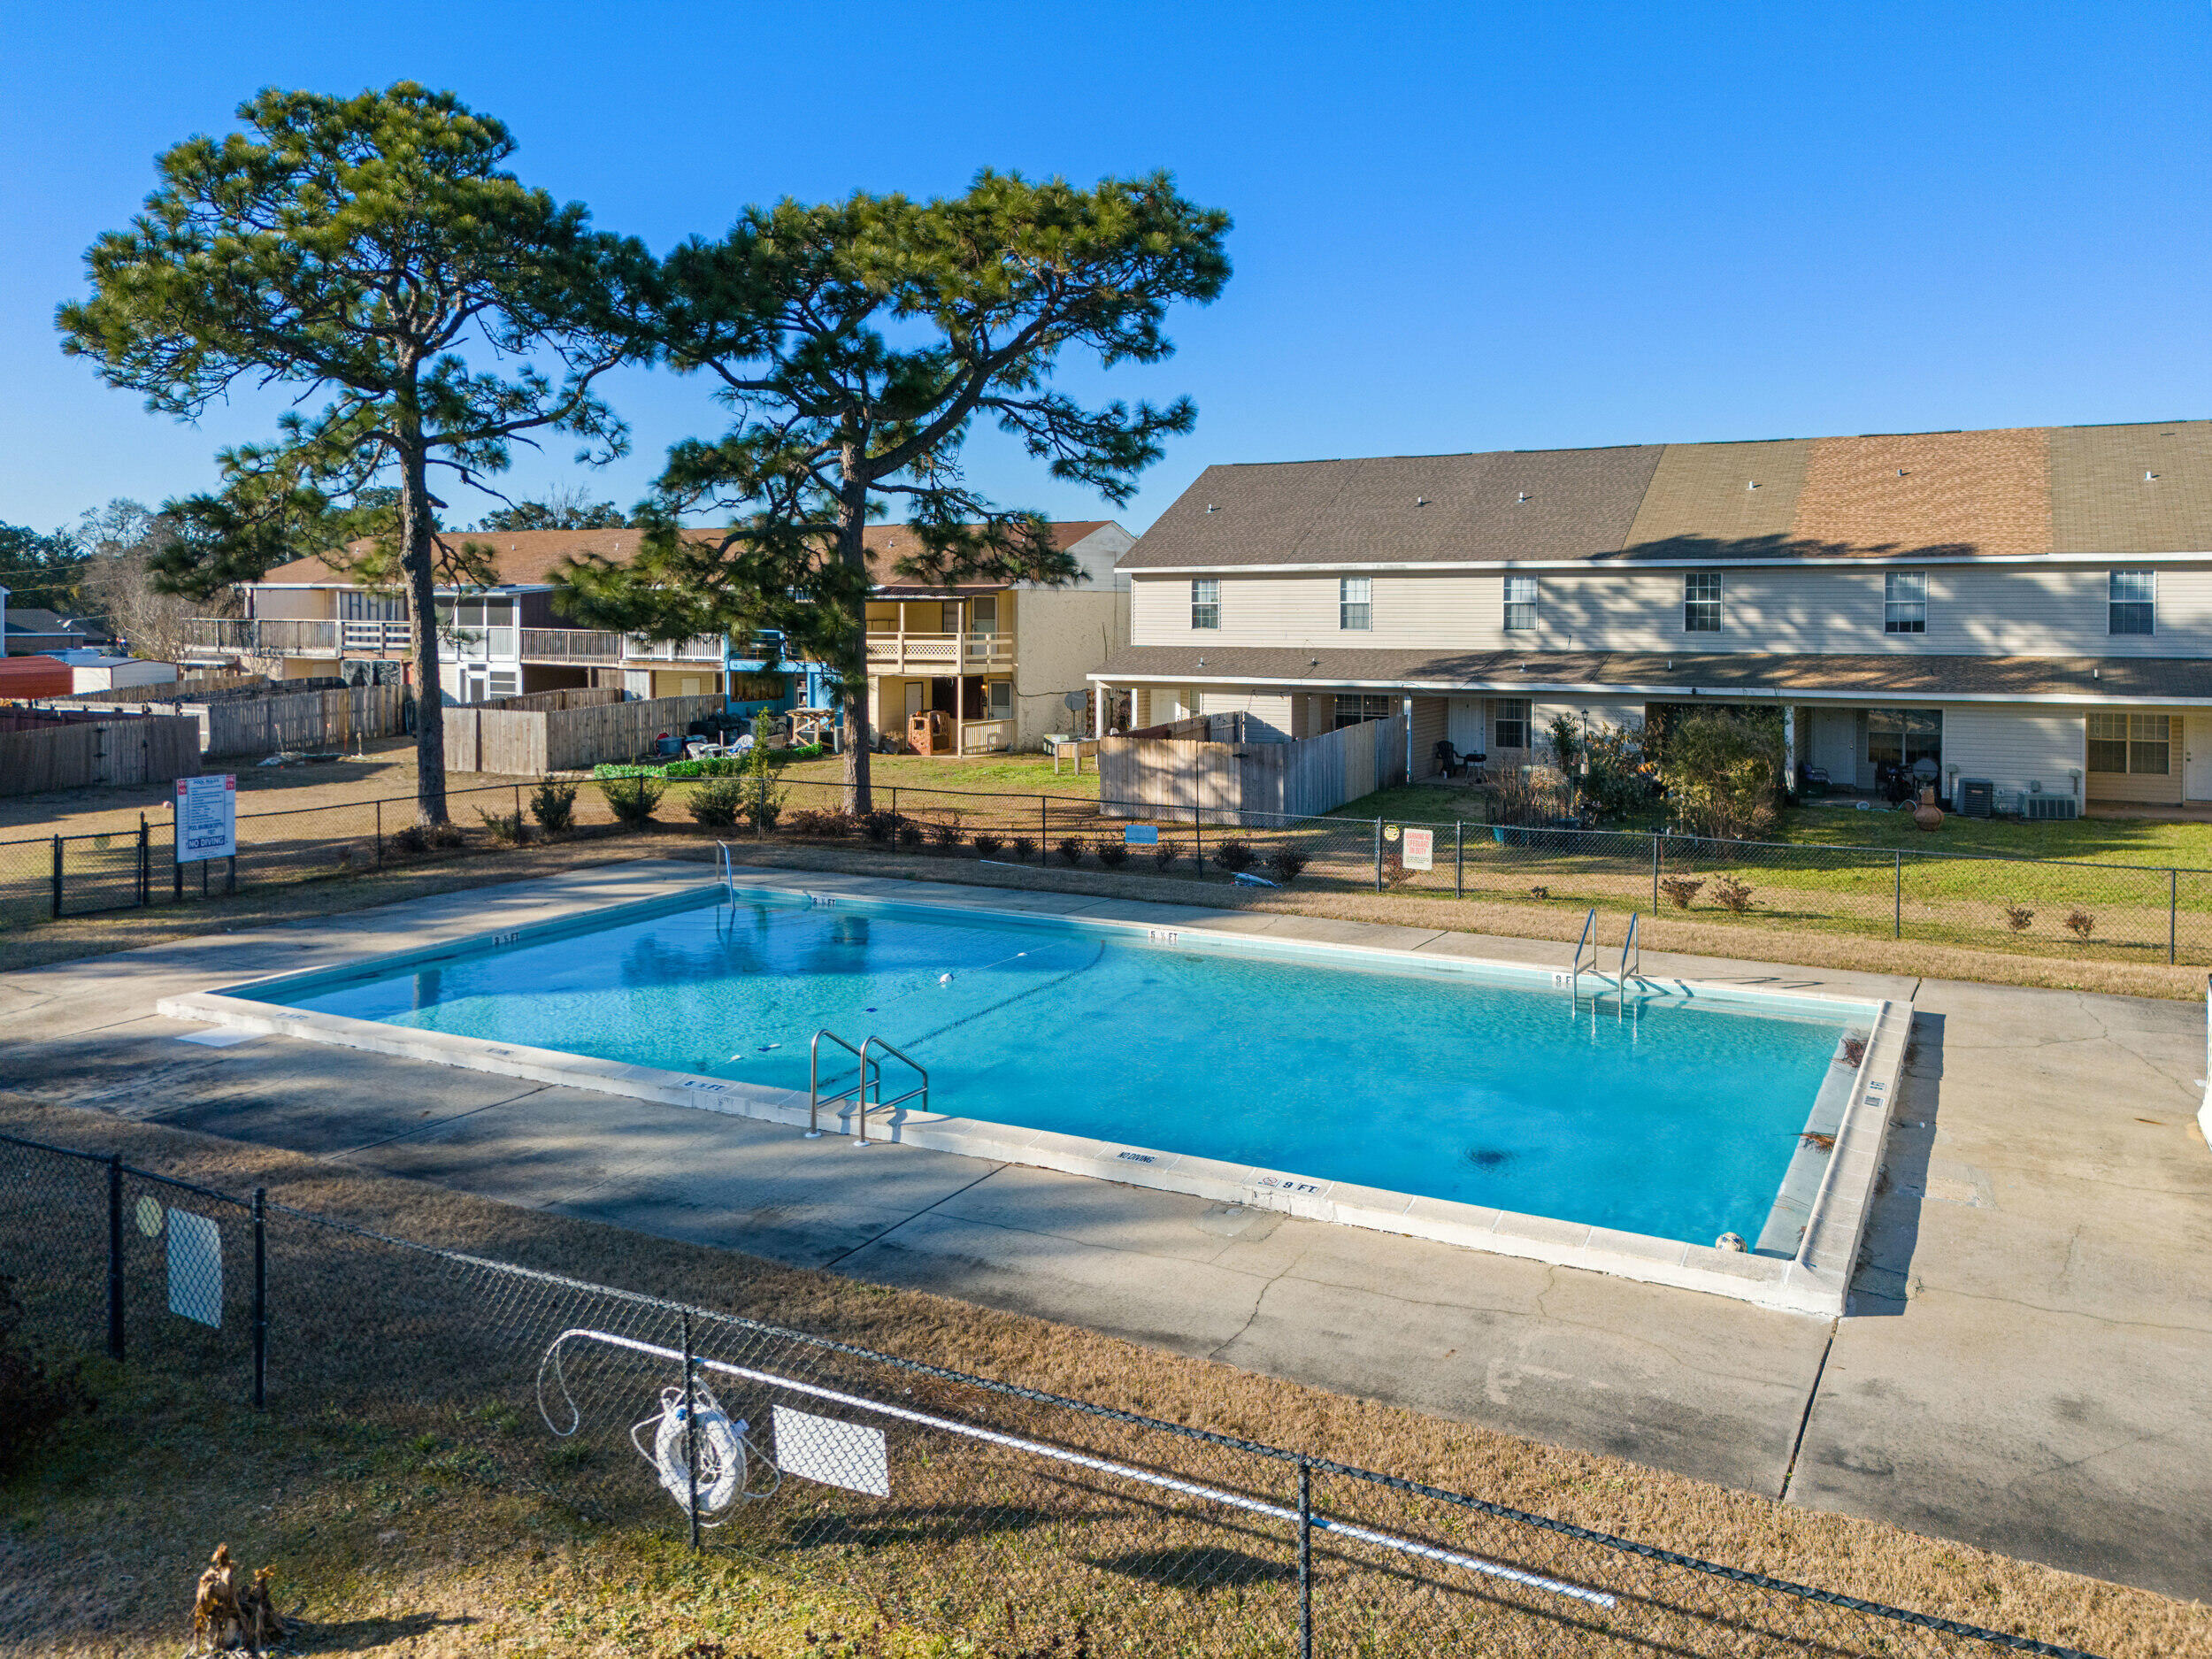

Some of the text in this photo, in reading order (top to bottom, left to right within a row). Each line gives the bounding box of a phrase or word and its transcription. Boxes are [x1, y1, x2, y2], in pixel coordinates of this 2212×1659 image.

[189, 839, 199, 848] NO
[200, 837, 223, 846] DIVING
[1128, 1153, 1155, 1163] DIVING
